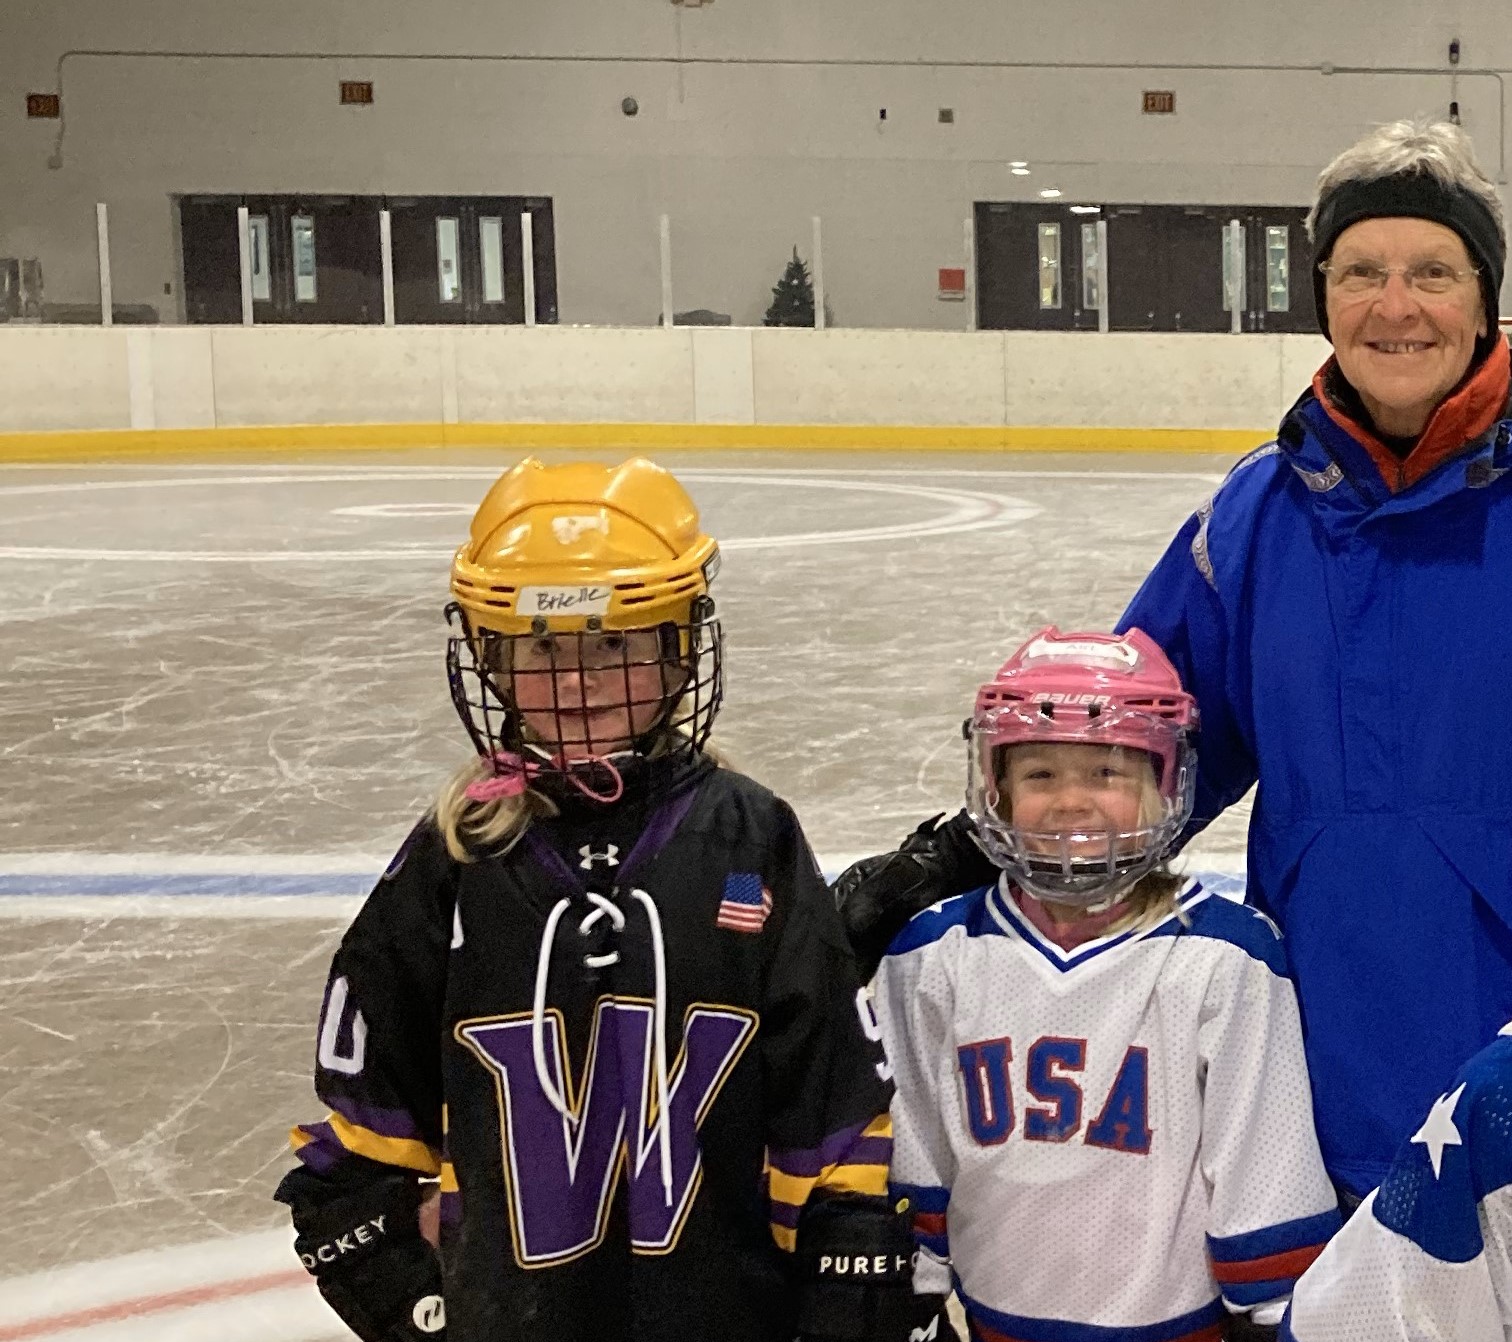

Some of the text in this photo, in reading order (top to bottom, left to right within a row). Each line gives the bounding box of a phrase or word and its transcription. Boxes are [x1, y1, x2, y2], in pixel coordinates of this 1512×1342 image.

[453, 993, 760, 1270] W
[957, 1035, 1153, 1156] USA
[301, 1214, 387, 1269] OCKEY
[819, 1255, 887, 1275] PURE
